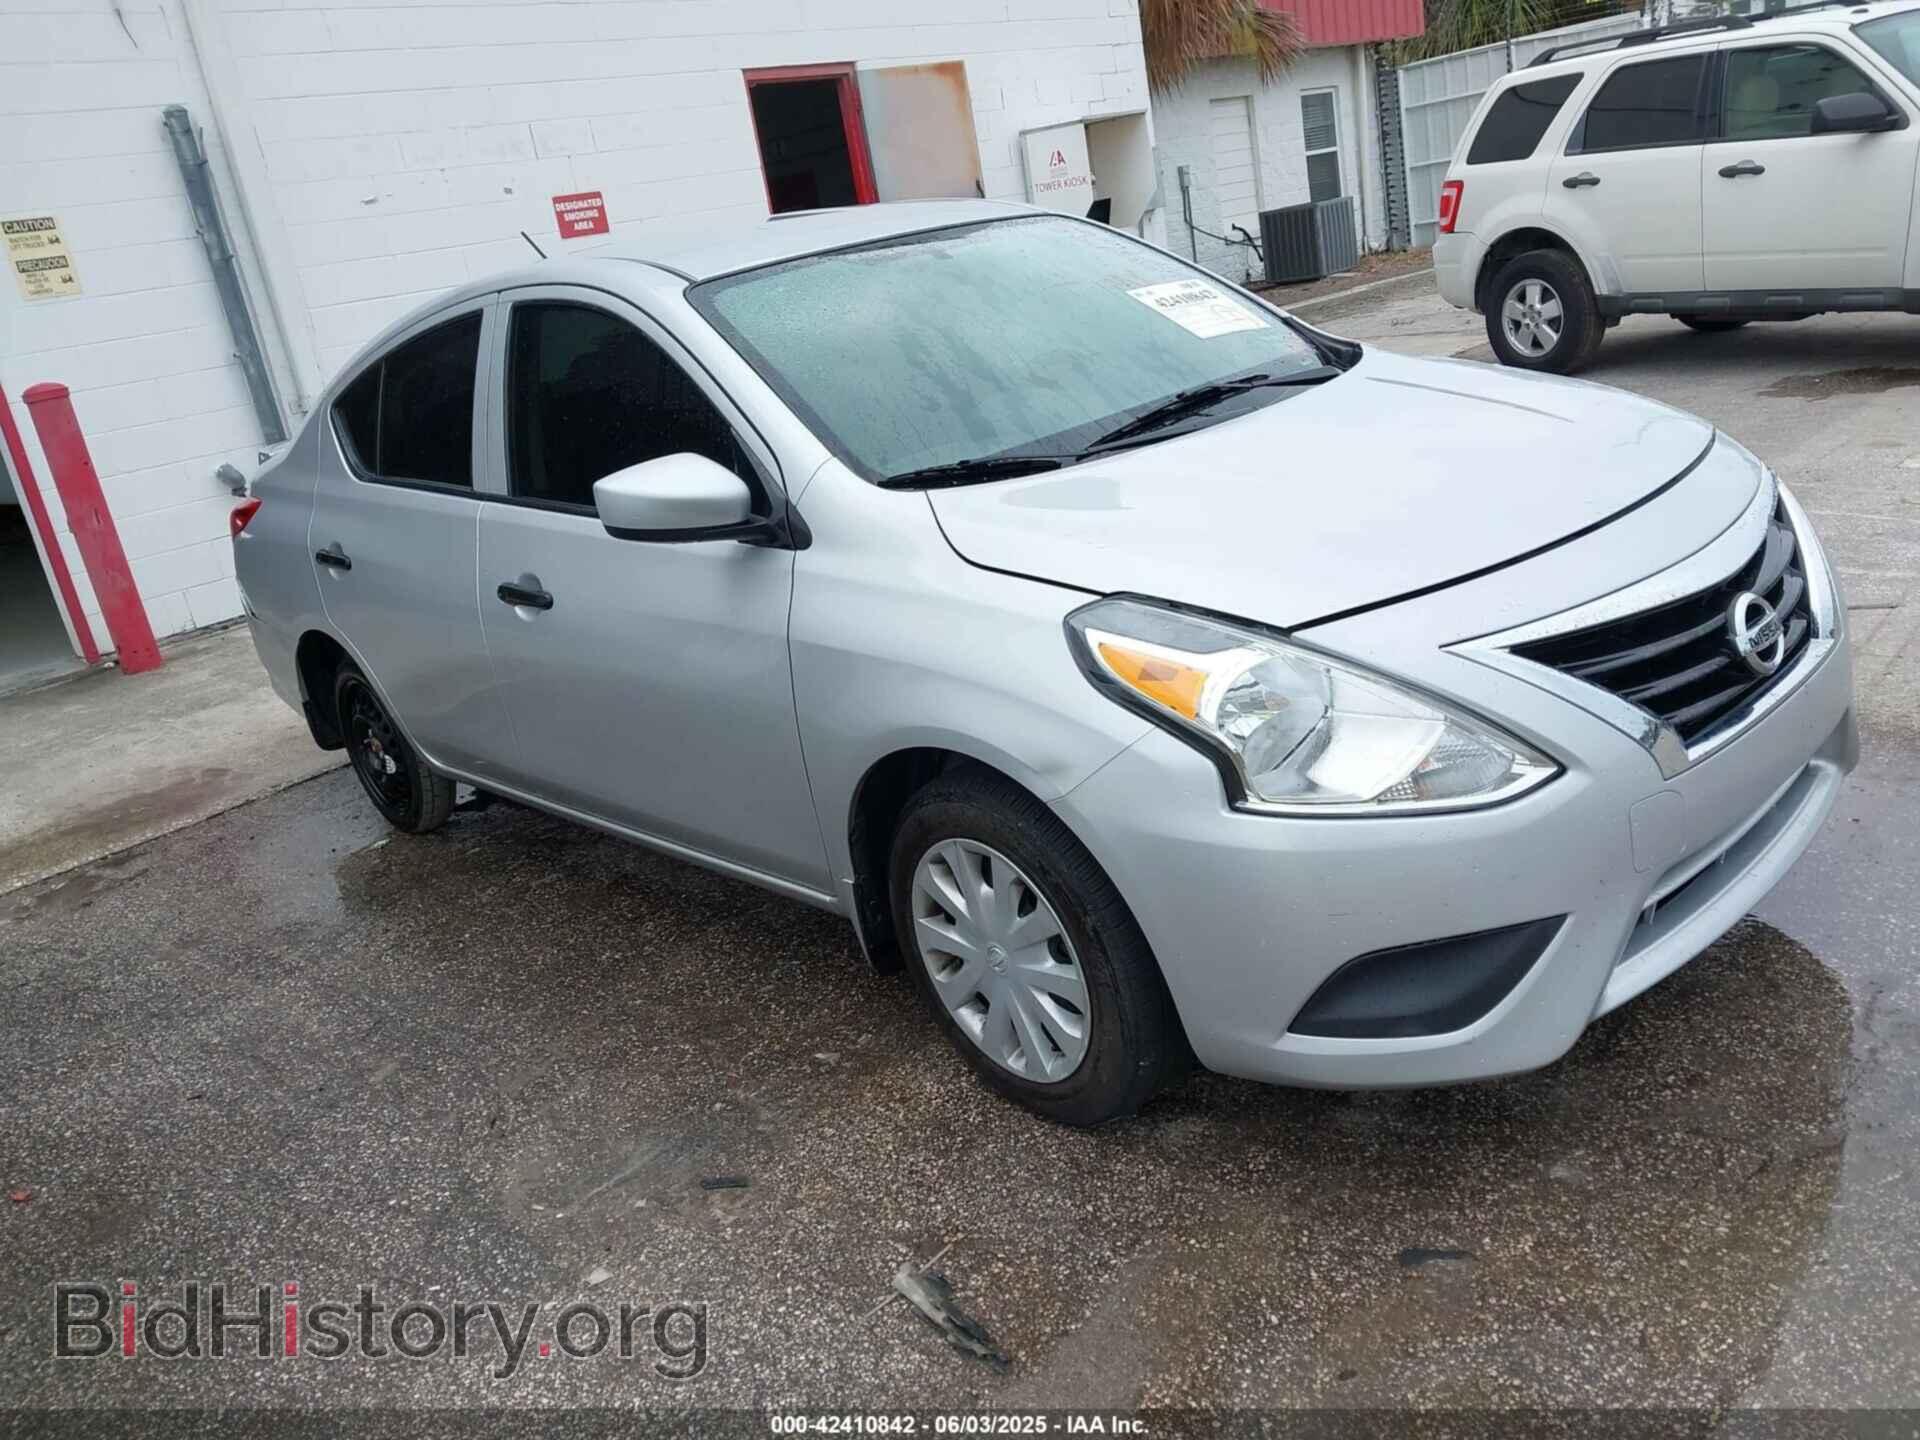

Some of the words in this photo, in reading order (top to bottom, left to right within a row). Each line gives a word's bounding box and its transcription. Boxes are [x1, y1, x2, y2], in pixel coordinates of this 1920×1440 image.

[1035, 179, 1063, 193] TOWER
[1063, 176, 1088, 188] KIOSK
[555, 198, 602, 212] DESIGNATED
[563, 209, 599, 221] SMOKING
[4, 218, 55, 232] CAUTION
[574, 220, 594, 230] AREA
